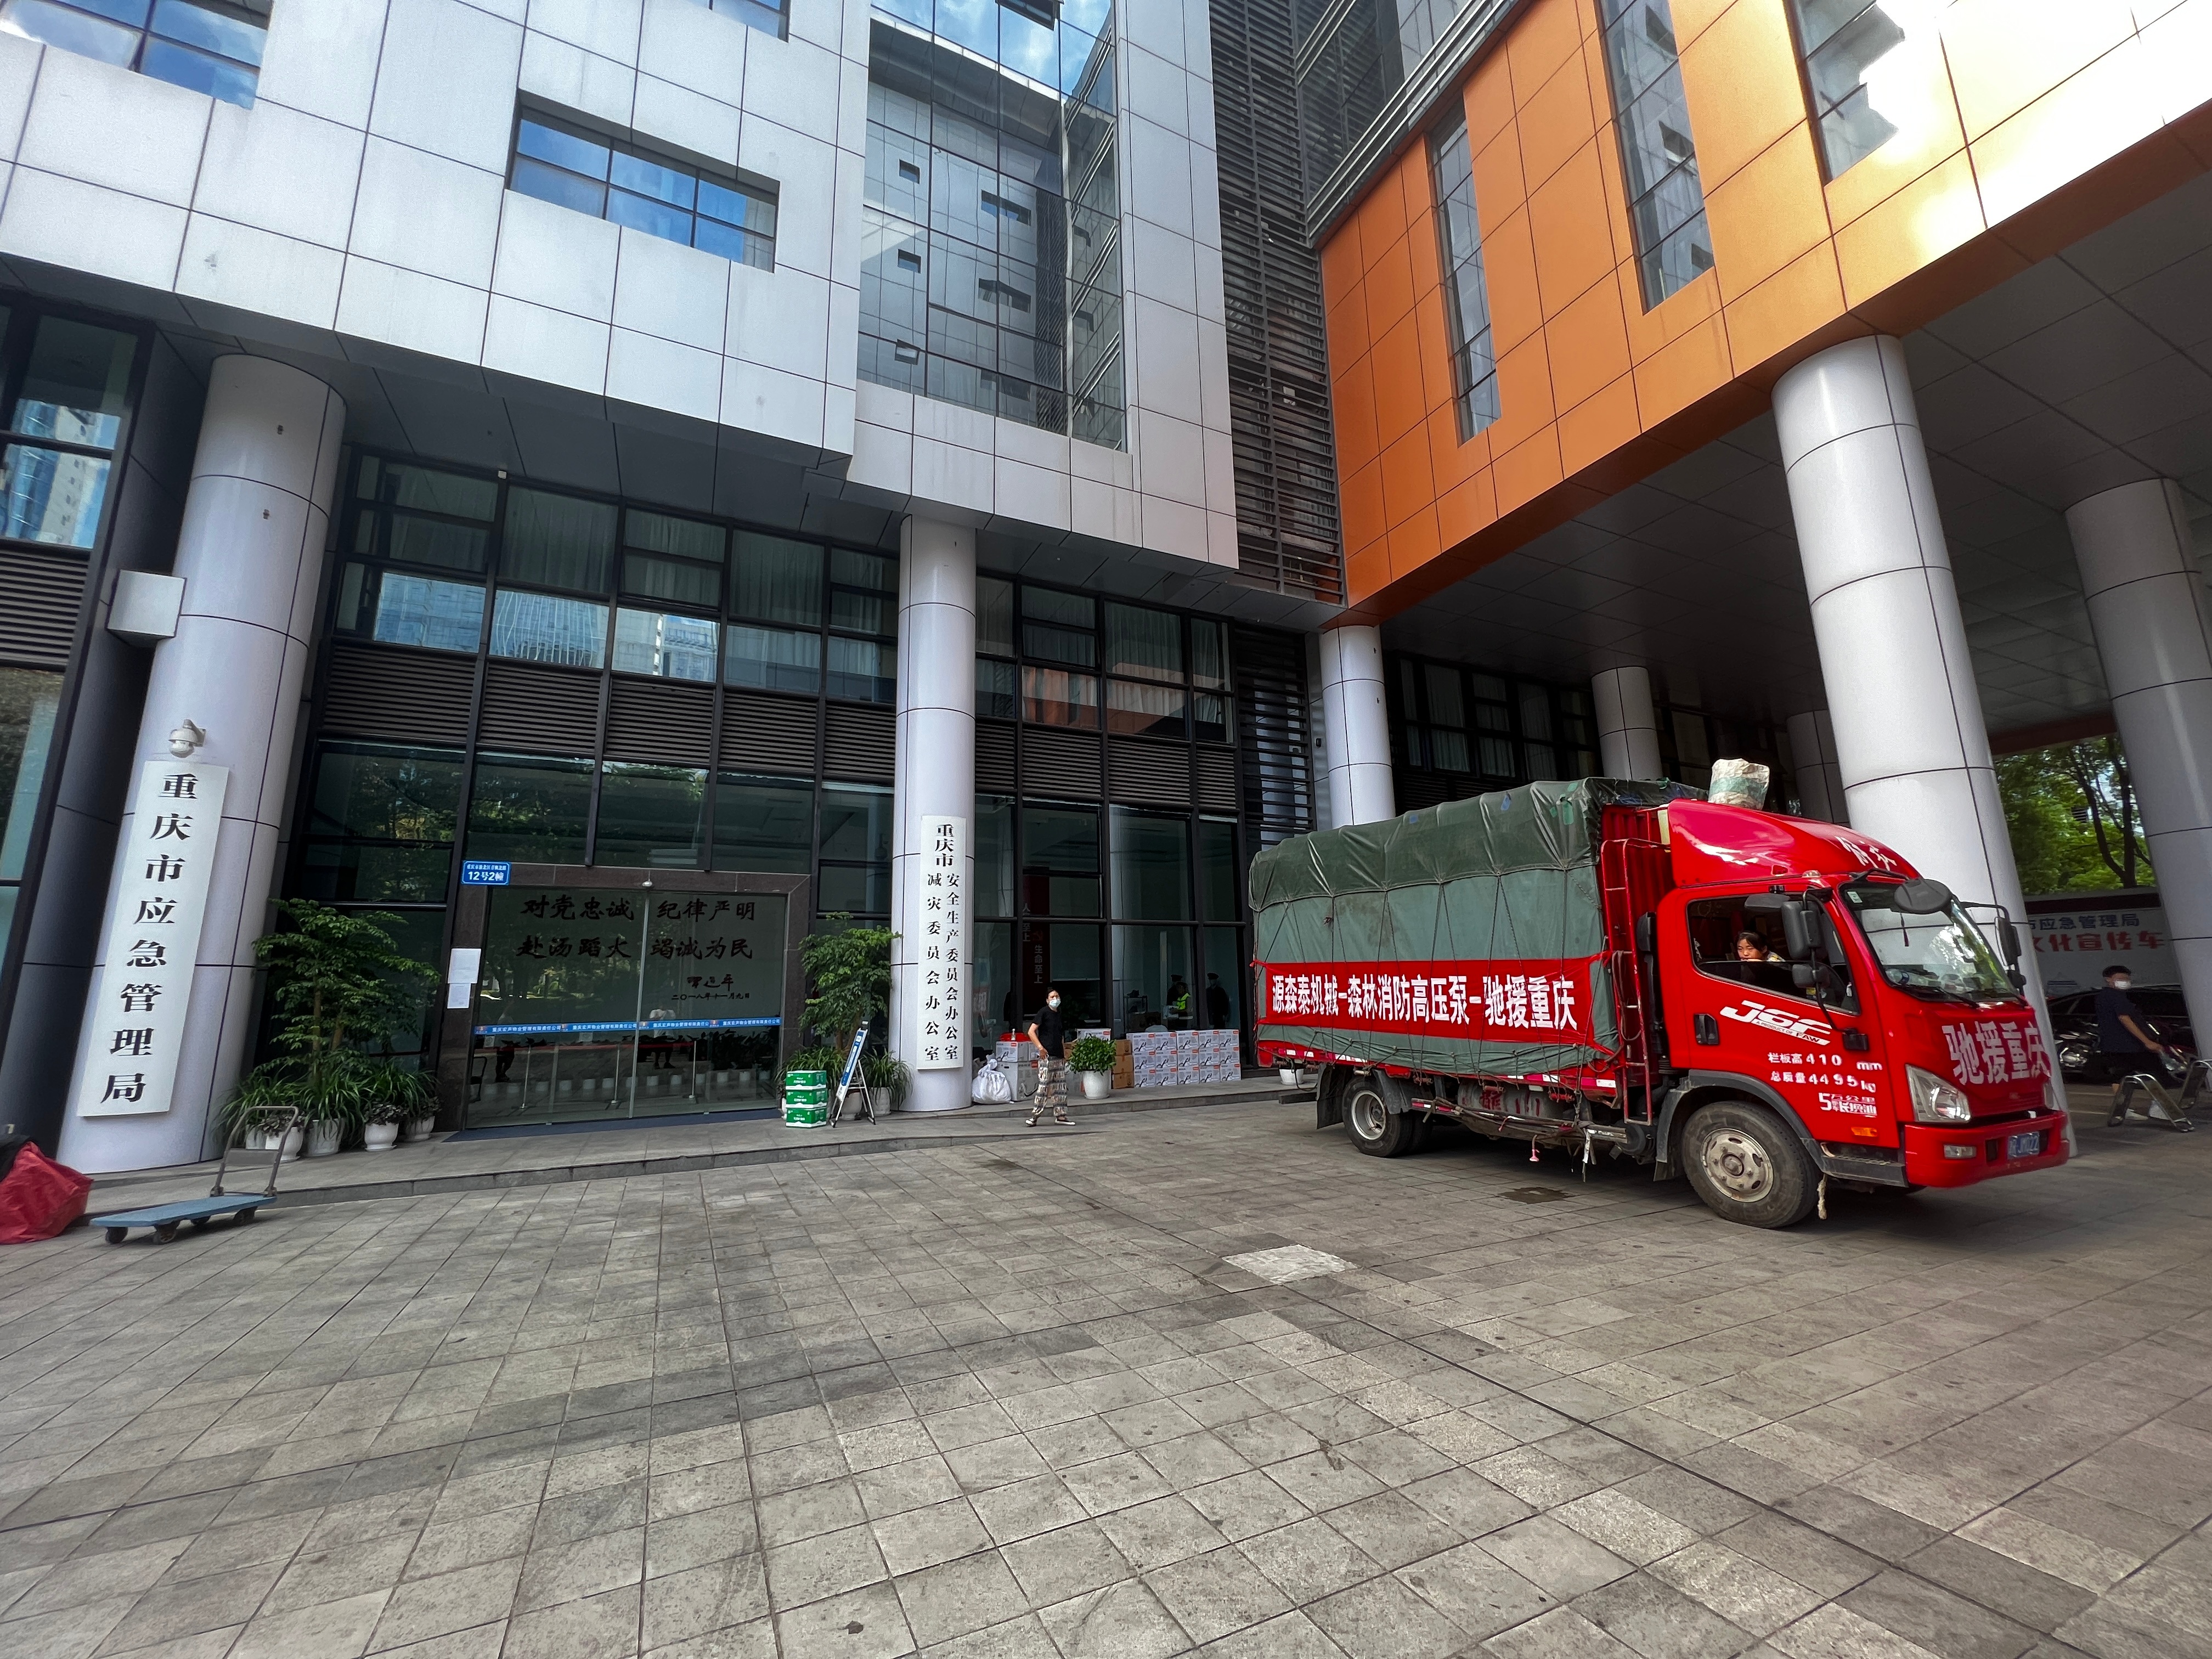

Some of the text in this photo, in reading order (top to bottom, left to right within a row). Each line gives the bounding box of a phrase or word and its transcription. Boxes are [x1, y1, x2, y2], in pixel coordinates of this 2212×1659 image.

[935, 824, 955, 867] 重庆市
[521, 894, 755, 922] 对党忠诚 纪律严明
[1023, 903, 1031, 942] 人至上
[101, 774, 199, 1103] 重庆市应急管理局
[516, 935, 752, 960] 赴汤蹈火 竭诚为民
[924, 873, 941, 1062] 减灾委员会办公室
[945, 873, 960, 1060] 安全生产委员会办公室
[1034, 944, 1043, 984] 生命至上
[1761, 1022, 1785, 1031] PRODUCT
[1796, 1032, 1820, 1042] FAW
[1857, 1061, 1883, 1070] mm
[1942, 1021, 2051, 1085] 驰援重庆
